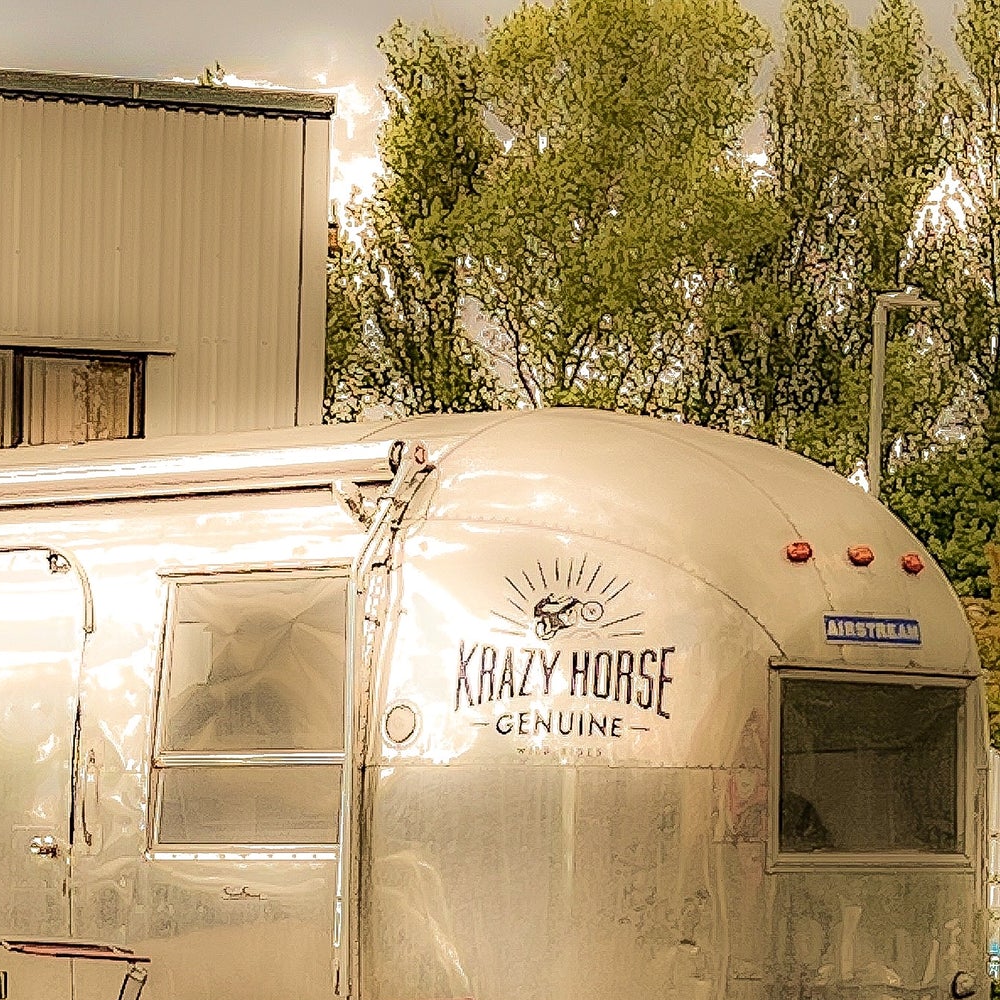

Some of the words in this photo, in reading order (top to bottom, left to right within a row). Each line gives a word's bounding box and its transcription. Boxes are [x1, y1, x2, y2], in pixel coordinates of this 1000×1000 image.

[826, 619, 919, 640] AIRSTREAM
[455, 640, 561, 711] KRAZY
[570, 646, 676, 719] HORSE
[496, 711, 624, 738] GENUINE
